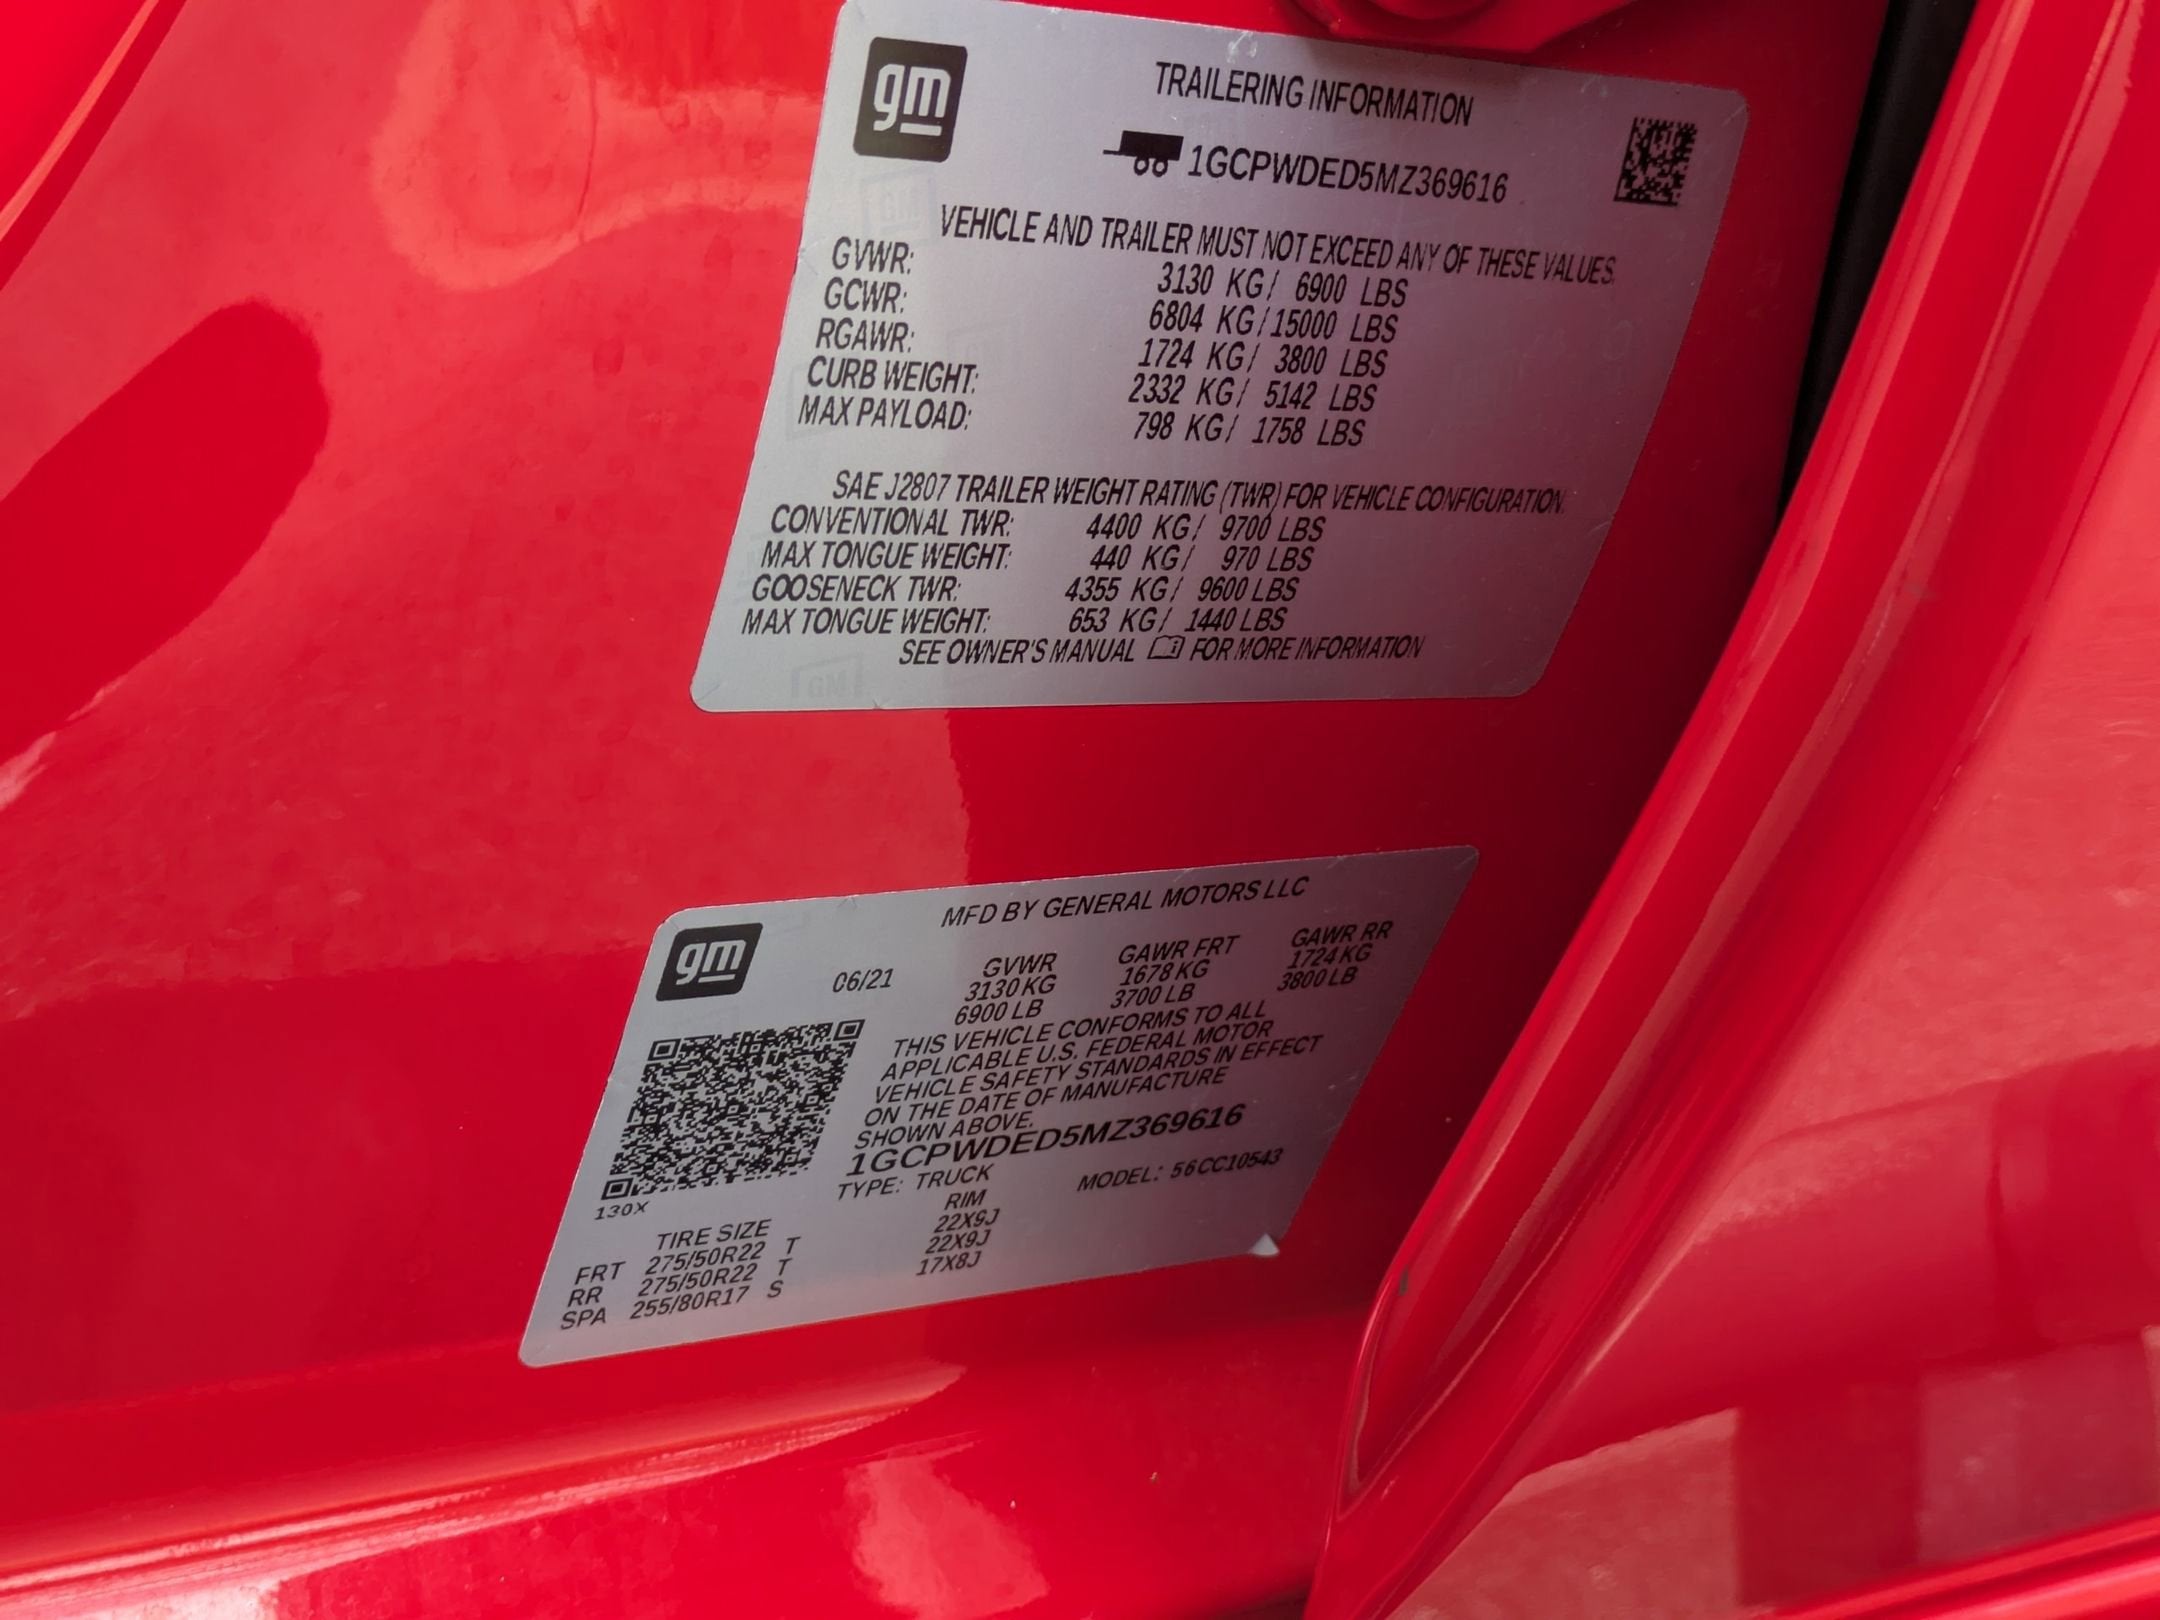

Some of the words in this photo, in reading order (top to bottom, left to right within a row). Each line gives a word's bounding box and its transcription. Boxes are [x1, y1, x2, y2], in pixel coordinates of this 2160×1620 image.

[1156, 61, 1304, 108] TRAILERING
[1309, 80, 1474, 126] INFORMATION
[1188, 145, 1509, 203] 1GCPWDED5MZ369616
[942, 204, 1041, 243] VEHICLE
[1043, 213, 1093, 247] AND
[1102, 217, 1193, 255] TRAILER
[1197, 225, 1259, 259] MUST
[1261, 230, 1309, 262] NOT
[1309, 234, 1393, 269] EXCEED
[1396, 241, 1441, 271] ANY
[1443, 243, 1473, 274] OF
[1477, 247, 1541, 279] THESE
[832, 236, 913, 274] GVWR:
[1158, 261, 1214, 295] 3130
[1296, 271, 1347, 304] 6900
[1360, 277, 1408, 308] LBS
[824, 277, 907, 313] GCWR:
[1149, 299, 1205, 333] 6804
[1350, 313, 1398, 344] LBS
[816, 317, 914, 352] RGAWR:
[1138, 338, 1196, 369] 1724
[1274, 344, 1327, 375] 3800
[1339, 349, 1388, 378] LBS
[808, 355, 877, 389] CURB
[884, 360, 978, 394] WEIGHT:
[1128, 372, 1186, 404] 2332
[1264, 380, 1317, 410] 5142
[1328, 383, 1377, 412] LBS
[798, 395, 854, 426] MAX
[856, 397, 972, 430] PAYLOAD:
[1134, 411, 1175, 440] 798
[1251, 416, 1306, 445] 1758
[1317, 419, 1366, 446] LBS
[833, 470, 883, 500] SAE
[884, 472, 951, 501] J2807
[956, 474, 1050, 503] TRAILER
[1053, 477, 1140, 506] WEIGHT
[1139, 479, 1218, 507] RATING
[1219, 480, 1282, 514] (TWR)
[1283, 482, 1328, 509] FOR
[1332, 484, 1415, 511] VEHICLE
[771, 504, 948, 536] CONVENTIONAL
[960, 509, 1014, 536] TWR:
[1086, 512, 1142, 540] 4400
[1220, 514, 1271, 541] 9700
[1277, 516, 1326, 542] LBS
[761, 540, 816, 568] MAX
[822, 540, 919, 569] TONGUE
[921, 542, 1012, 570] WEIGHT:
[1090, 544, 1131, 571] 440
[1221, 545, 1261, 571] 970
[1266, 546, 1315, 572] LBS
[752, 573, 902, 601] GOOSENECK
[908, 576, 961, 601] TWR:
[1065, 575, 1122, 602] 4355
[1198, 576, 1249, 602] 9600
[1251, 576, 1300, 602] LBS
[742, 608, 797, 634] MAX
[802, 607, 898, 634] TONGUE
[901, 607, 991, 634] WEIGHT:
[1069, 607, 1110, 633] 653
[1184, 607, 1237, 632] 1440
[1239, 606, 1288, 632] LBS
[899, 639, 946, 665] SEE
[947, 638, 1048, 664] OWNER'S
[1049, 638, 1135, 663] MANUAL
[1189, 636, 1234, 661] FOR
[1234, 636, 1297, 660] MORE
[1294, 635, 1425, 660] INFORMATION
[941, 903, 997, 927] MFD
[1001, 899, 1040, 922] BY
[1043, 890, 1152, 918] GENERAL
[1160, 880, 1262, 908] MOTORS
[1263, 876, 1309, 899] LLC
[1118, 940, 1189, 964] GAWR
[1193, 935, 1240, 957] FRT
[1291, 924, 1358, 948] GAWR
[1360, 920, 1394, 941] RR
[983, 953, 1057, 978] GVWR
[1120, 962, 1174, 986] 1678
[1174, 959, 1210, 980] KG
[1287, 946, 1339, 969] 1724
[1338, 942, 1373, 964] KG
[833, 968, 893, 993] 06/21
[964, 977, 1020, 1002] 3130
[1021, 974, 1057, 996] KG
[1110, 985, 1162, 1009] 3700
[1164, 982, 1196, 1003] LB
[1277, 968, 1328, 992] 3800
[1328, 966, 1358, 986] LB
[894, 1034, 947, 1058] THIS
[954, 1023, 1054, 1051] VEHICLE
[1058, 1007, 1189, 1039] CONFORMS
[1194, 1004, 1223, 1024] TO
[1225, 1000, 1265, 1021] ALL
[955, 1001, 1008, 1026] 6900
[1011, 999, 1044, 1020] LB
[876, 1075, 977, 1104] VEHICLE
[980, 1064, 1072, 1091] SAFETY
[1073, 1047, 1211, 1080] STANDARDS
[1213, 1044, 1238, 1064] IN
[1240, 1034, 1324, 1061] EFFECT
[880, 1047, 1028, 1082] APPLICABLE
[1037, 1041, 1078, 1063] U.S.
[1086, 1030, 1186, 1058] FEDERAL
[1193, 1020, 1274, 1046] MOTOR
[864, 1106, 901, 1127] ON
[909, 1099, 955, 1122] THE
[958, 1091, 1017, 1116] DATE
[1024, 1087, 1058, 1107] OF
[1058, 1066, 1229, 1102] MANUFACTURE
[846, 1103, 1246, 1177] 1GCPWDED5MZ369616
[854, 1121, 946, 1149] SHOWN
[948, 1111, 1033, 1138] ABOVE.
[839, 1176, 903, 1200] TYPE:
[917, 1163, 994, 1190] TRUCK
[1077, 1166, 1163, 1191] MODEL:
[1170, 1147, 1284, 1179] 56CC10543
[595, 1201, 649, 1220] 130X
[944, 1189, 987, 1210] RIM
[658, 1227, 712, 1250] TIRE
[716, 1219, 771, 1242] SIZE
[934, 1208, 1000, 1233] 22X9J
[925, 1229, 991, 1254] 22X9J
[575, 1261, 626, 1285] FRT
[645, 1241, 766, 1275] 275/50R22
[787, 1237, 800, 1254] T
[916, 1251, 982, 1275] 17X8J
[568, 1286, 603, 1307] RR
[638, 1263, 757, 1297] 275/50R22
[779, 1258, 792, 1276] T
[561, 1307, 605, 1330] SPA
[630, 1285, 750, 1319] 255/80R17
[767, 1280, 783, 1298] S
